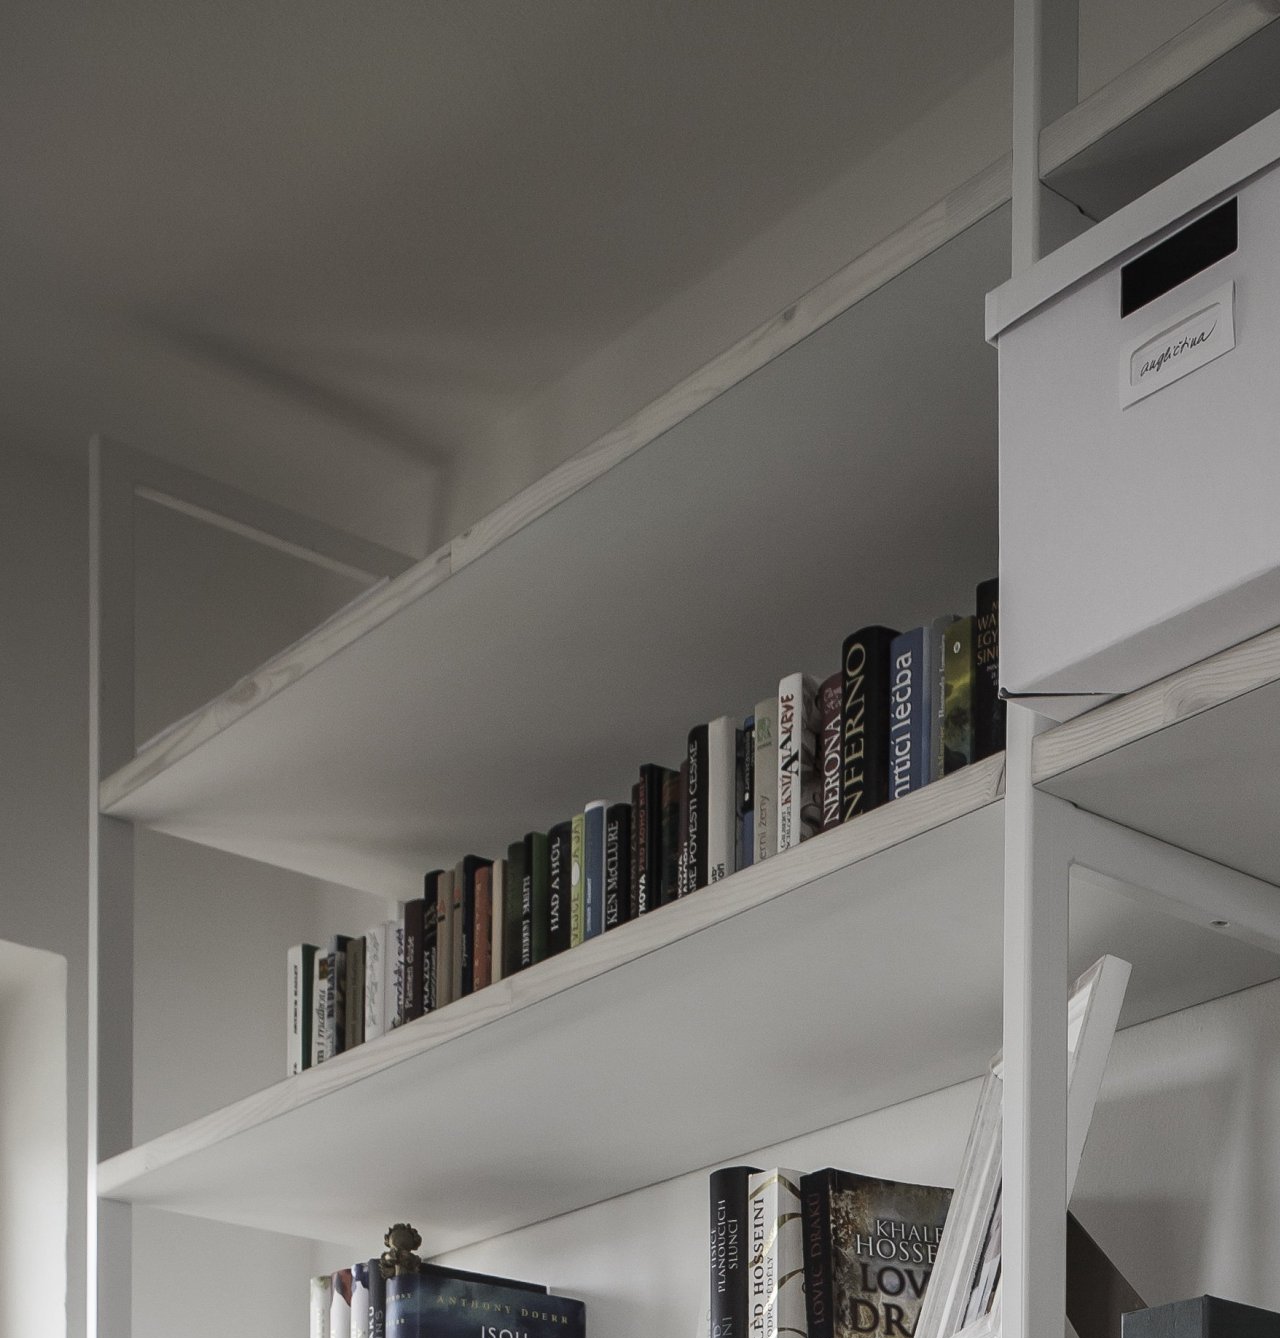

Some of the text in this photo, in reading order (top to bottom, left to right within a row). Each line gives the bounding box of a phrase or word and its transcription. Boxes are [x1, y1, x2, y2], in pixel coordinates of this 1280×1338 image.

[780, 693, 794, 733] KRVE
[891, 650, 912, 731] léčba
[843, 642, 866, 819] NFERNO
[823, 714, 841, 823] NERONA
[551, 875, 560, 931] HAD A
[607, 821, 619, 924] KEN McCLURE
[727, 1218, 738, 1269] SLUNCÍ
[753, 1198, 764, 1295] HOSSEINI
[876, 1219, 944, 1243] KHALE
[437, 1295, 568, 1325] ANTHONY DOERR
[812, 1263, 826, 1325] LOVEC
